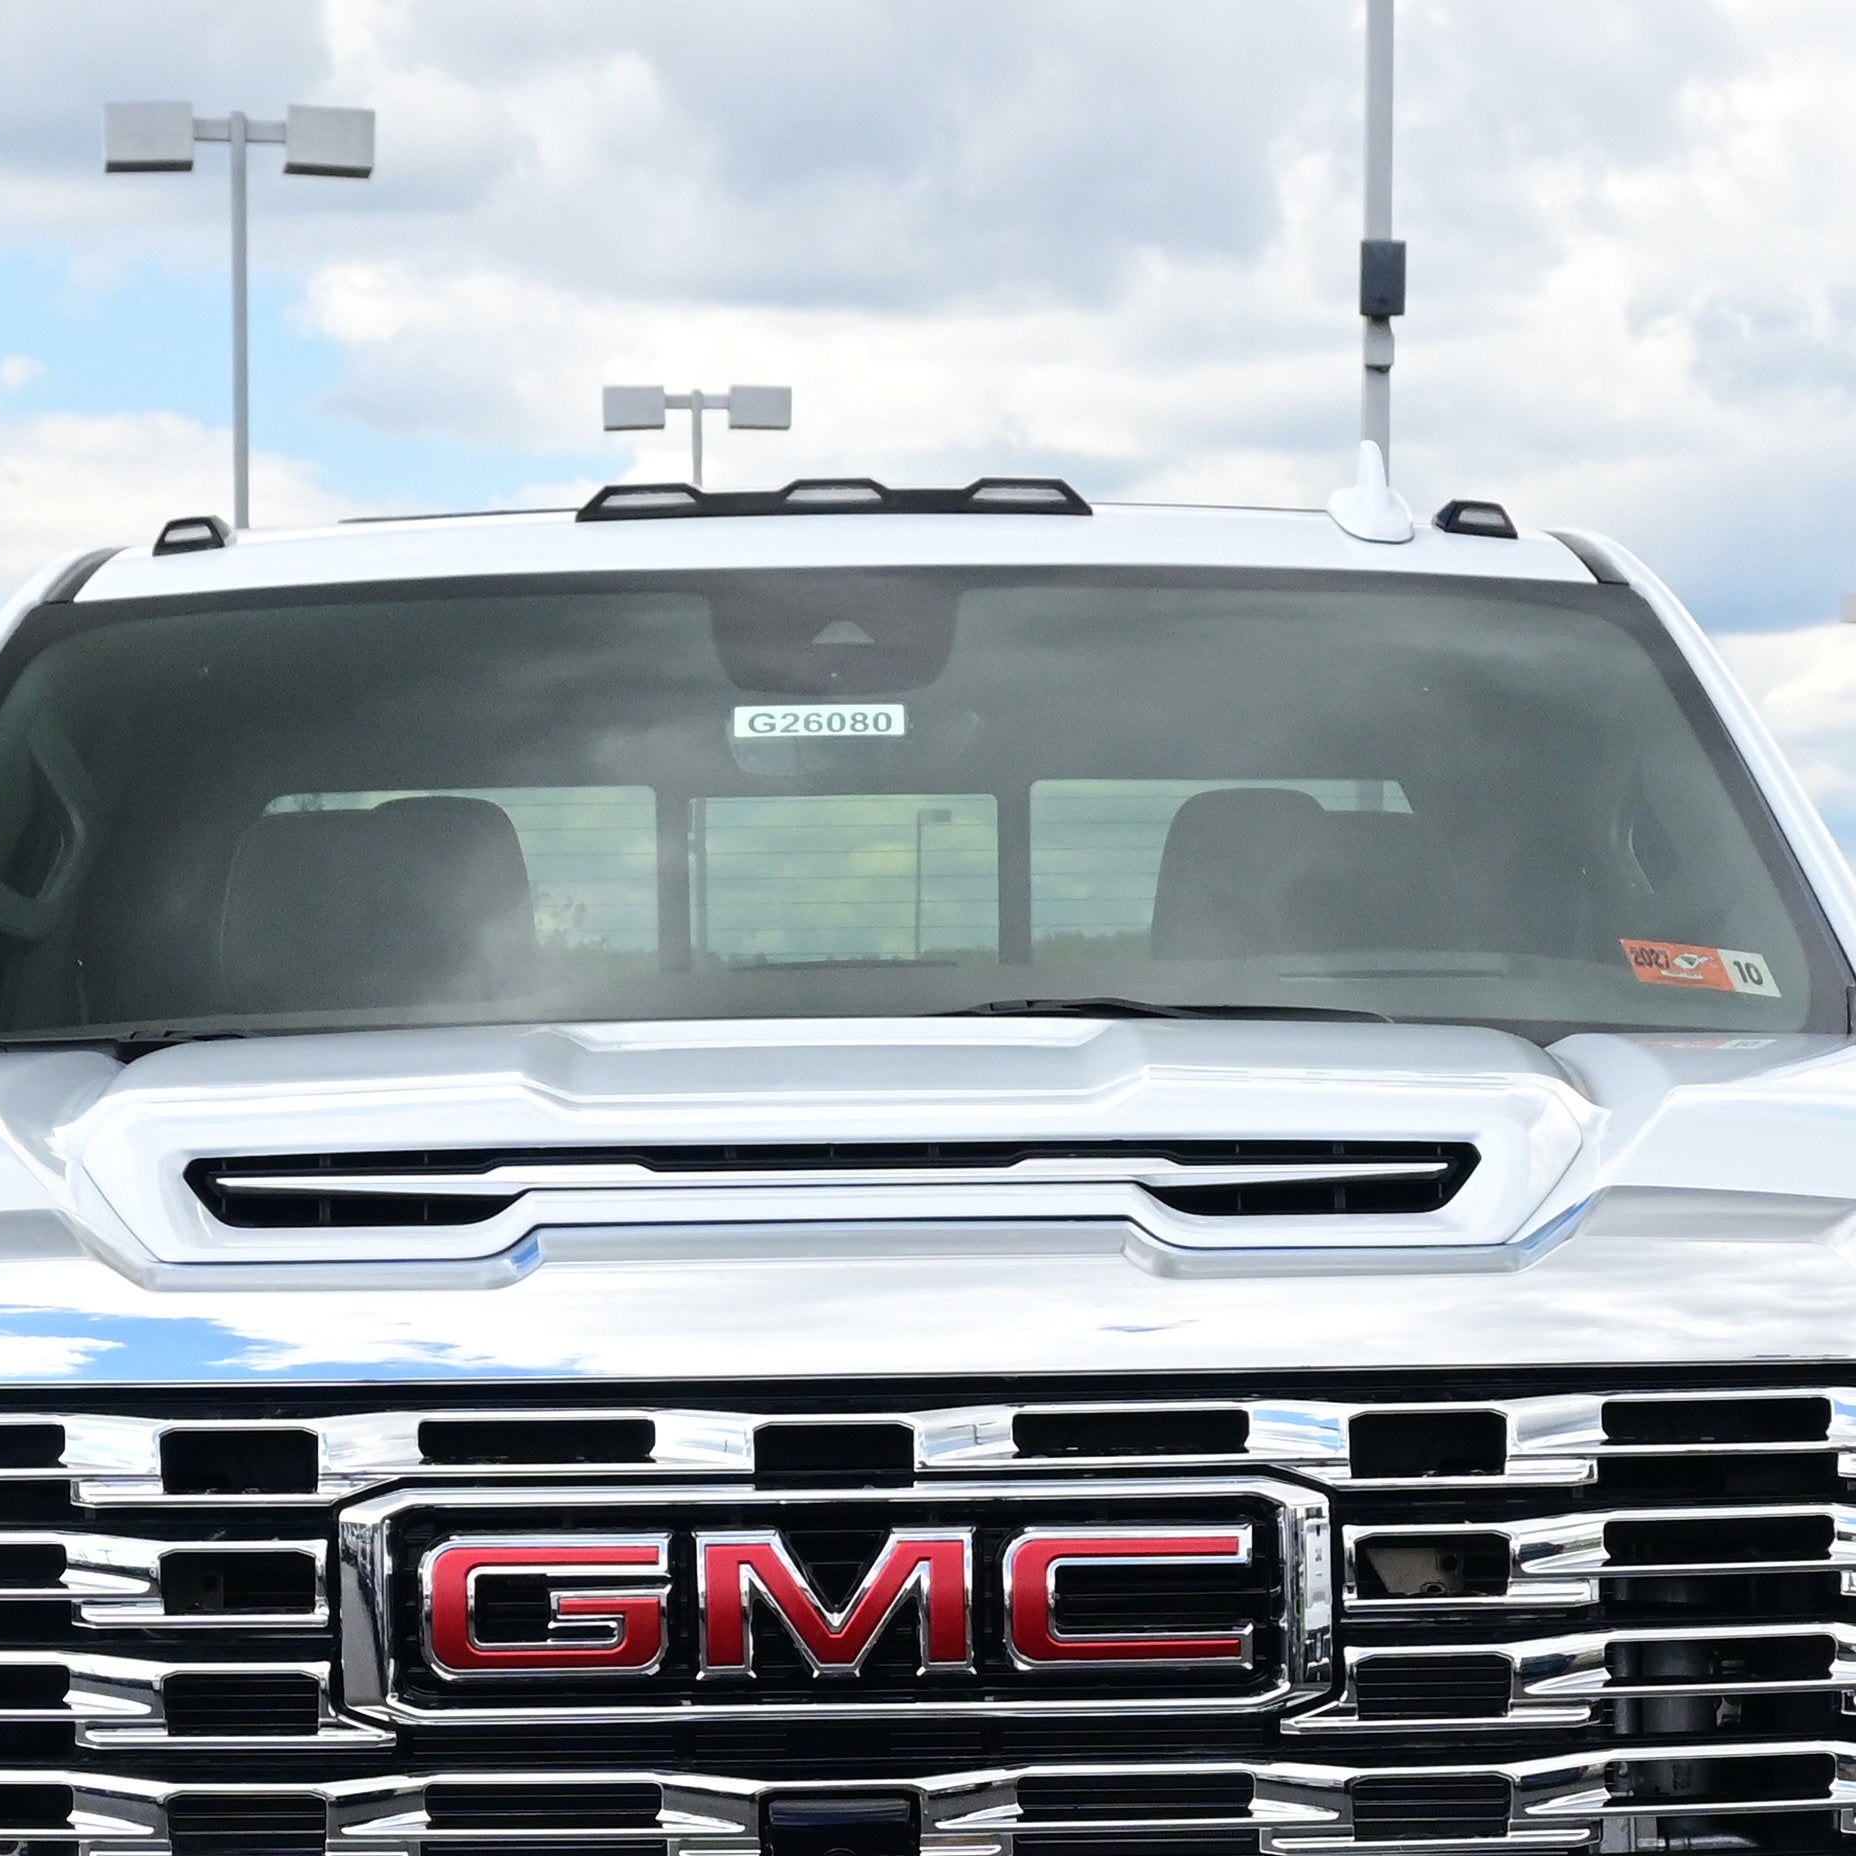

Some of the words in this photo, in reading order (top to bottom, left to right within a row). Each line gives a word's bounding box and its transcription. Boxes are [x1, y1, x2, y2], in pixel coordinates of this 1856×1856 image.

[748, 711, 893, 734] G26080
[1733, 960, 1764, 986] 10
[419, 1525, 1254, 1680] GMC
